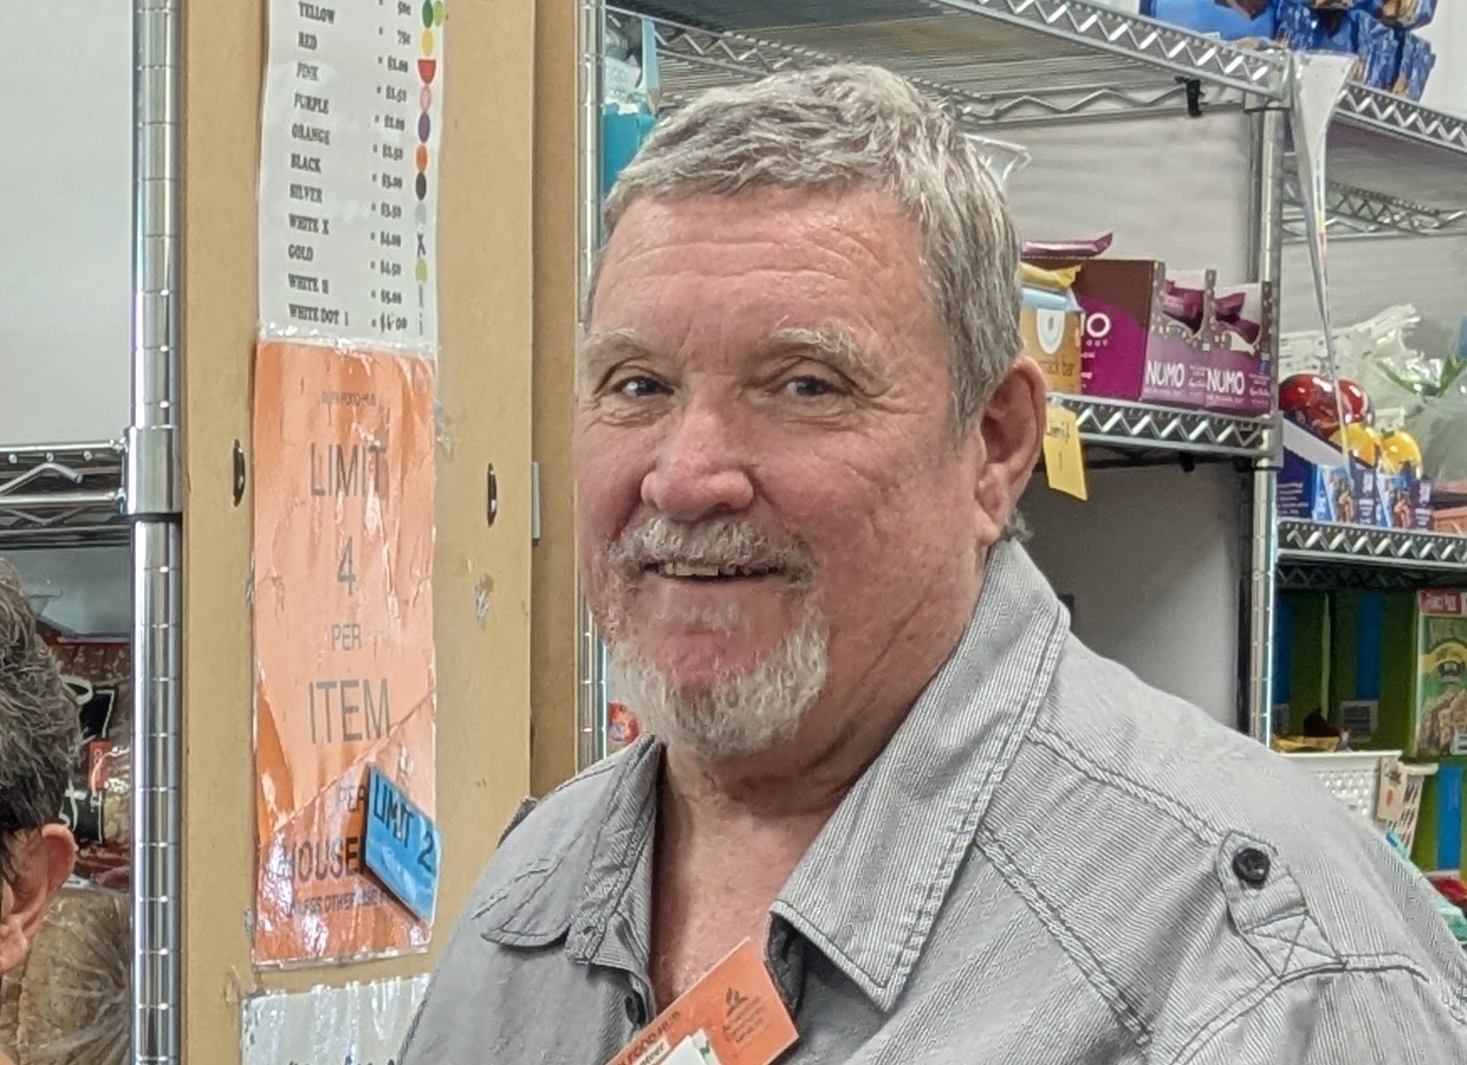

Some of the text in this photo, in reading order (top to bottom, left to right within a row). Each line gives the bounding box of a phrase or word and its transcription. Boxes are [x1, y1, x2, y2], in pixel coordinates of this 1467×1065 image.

[298, 32, 318, 50] RED
[296, 62, 318, 81] PINK
[294, 92, 329, 114] PURPLE
[291, 123, 330, 145] ORANGE
[290, 153, 321, 173] BLACK
[290, 183, 322, 203] SILVER
[288, 213, 319, 234] WHITE
[288, 244, 314, 261] GOLD
[288, 273, 319, 292] WHITE
[288, 303, 319, 322] WHITE
[320, 307, 339, 325] DOT
[310, 442, 387, 497] LIMIT
[337, 535, 356, 596] 4
[331, 623, 362, 651] PER
[309, 678, 391, 744] ITEM
[373, 773, 436, 874] LIMIT 2
[280, 827, 366, 883] HOUSE
